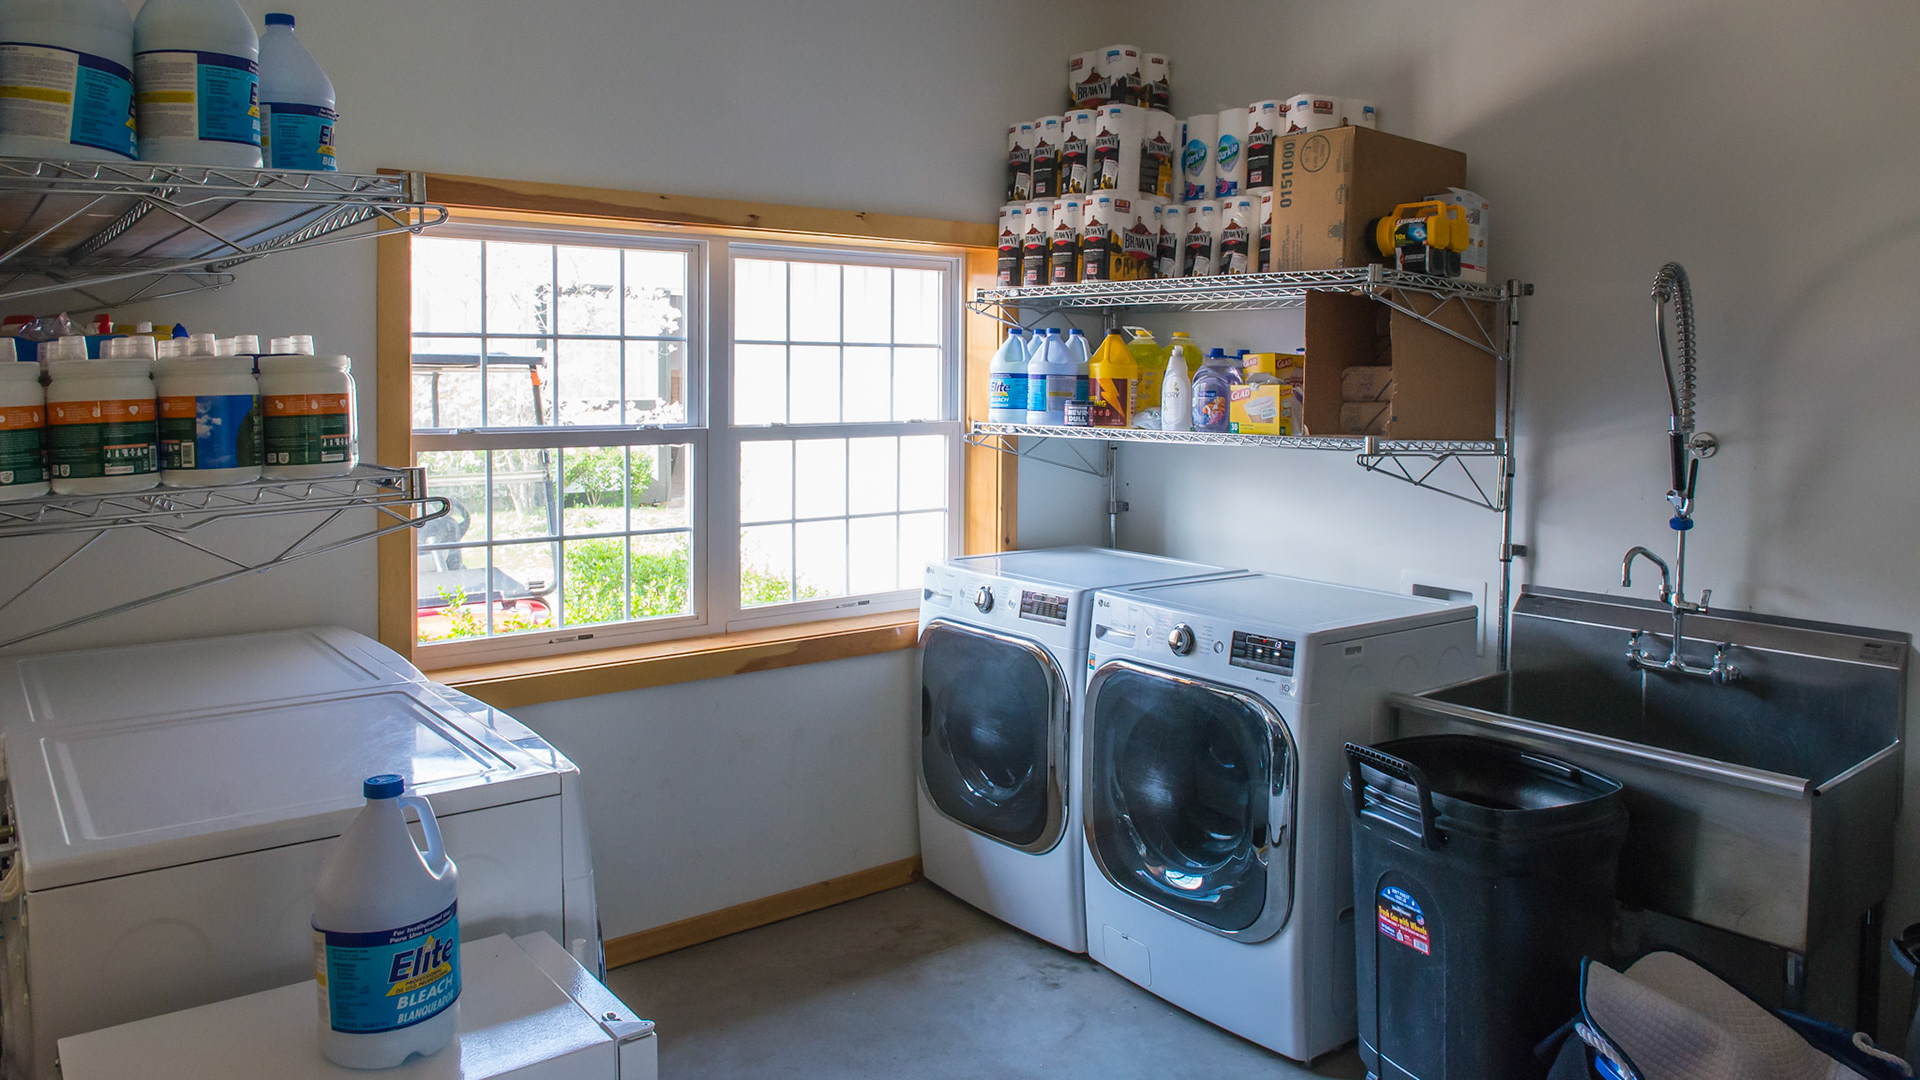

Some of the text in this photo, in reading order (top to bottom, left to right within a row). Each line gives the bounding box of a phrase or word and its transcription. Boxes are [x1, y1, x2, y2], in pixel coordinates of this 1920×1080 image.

[1077, 81, 1107, 100] BRAWNY
[1125, 232, 1155, 252] BRAWNY
[1243, 357, 1257, 367] GLAD
[991, 382, 1010, 392] Elite
[1231, 388, 1250, 401] GLAD
[387, 937, 454, 984] Elite
[396, 972, 454, 1010] BLEACH
[397, 989, 454, 1024] BLANQUEADOR
